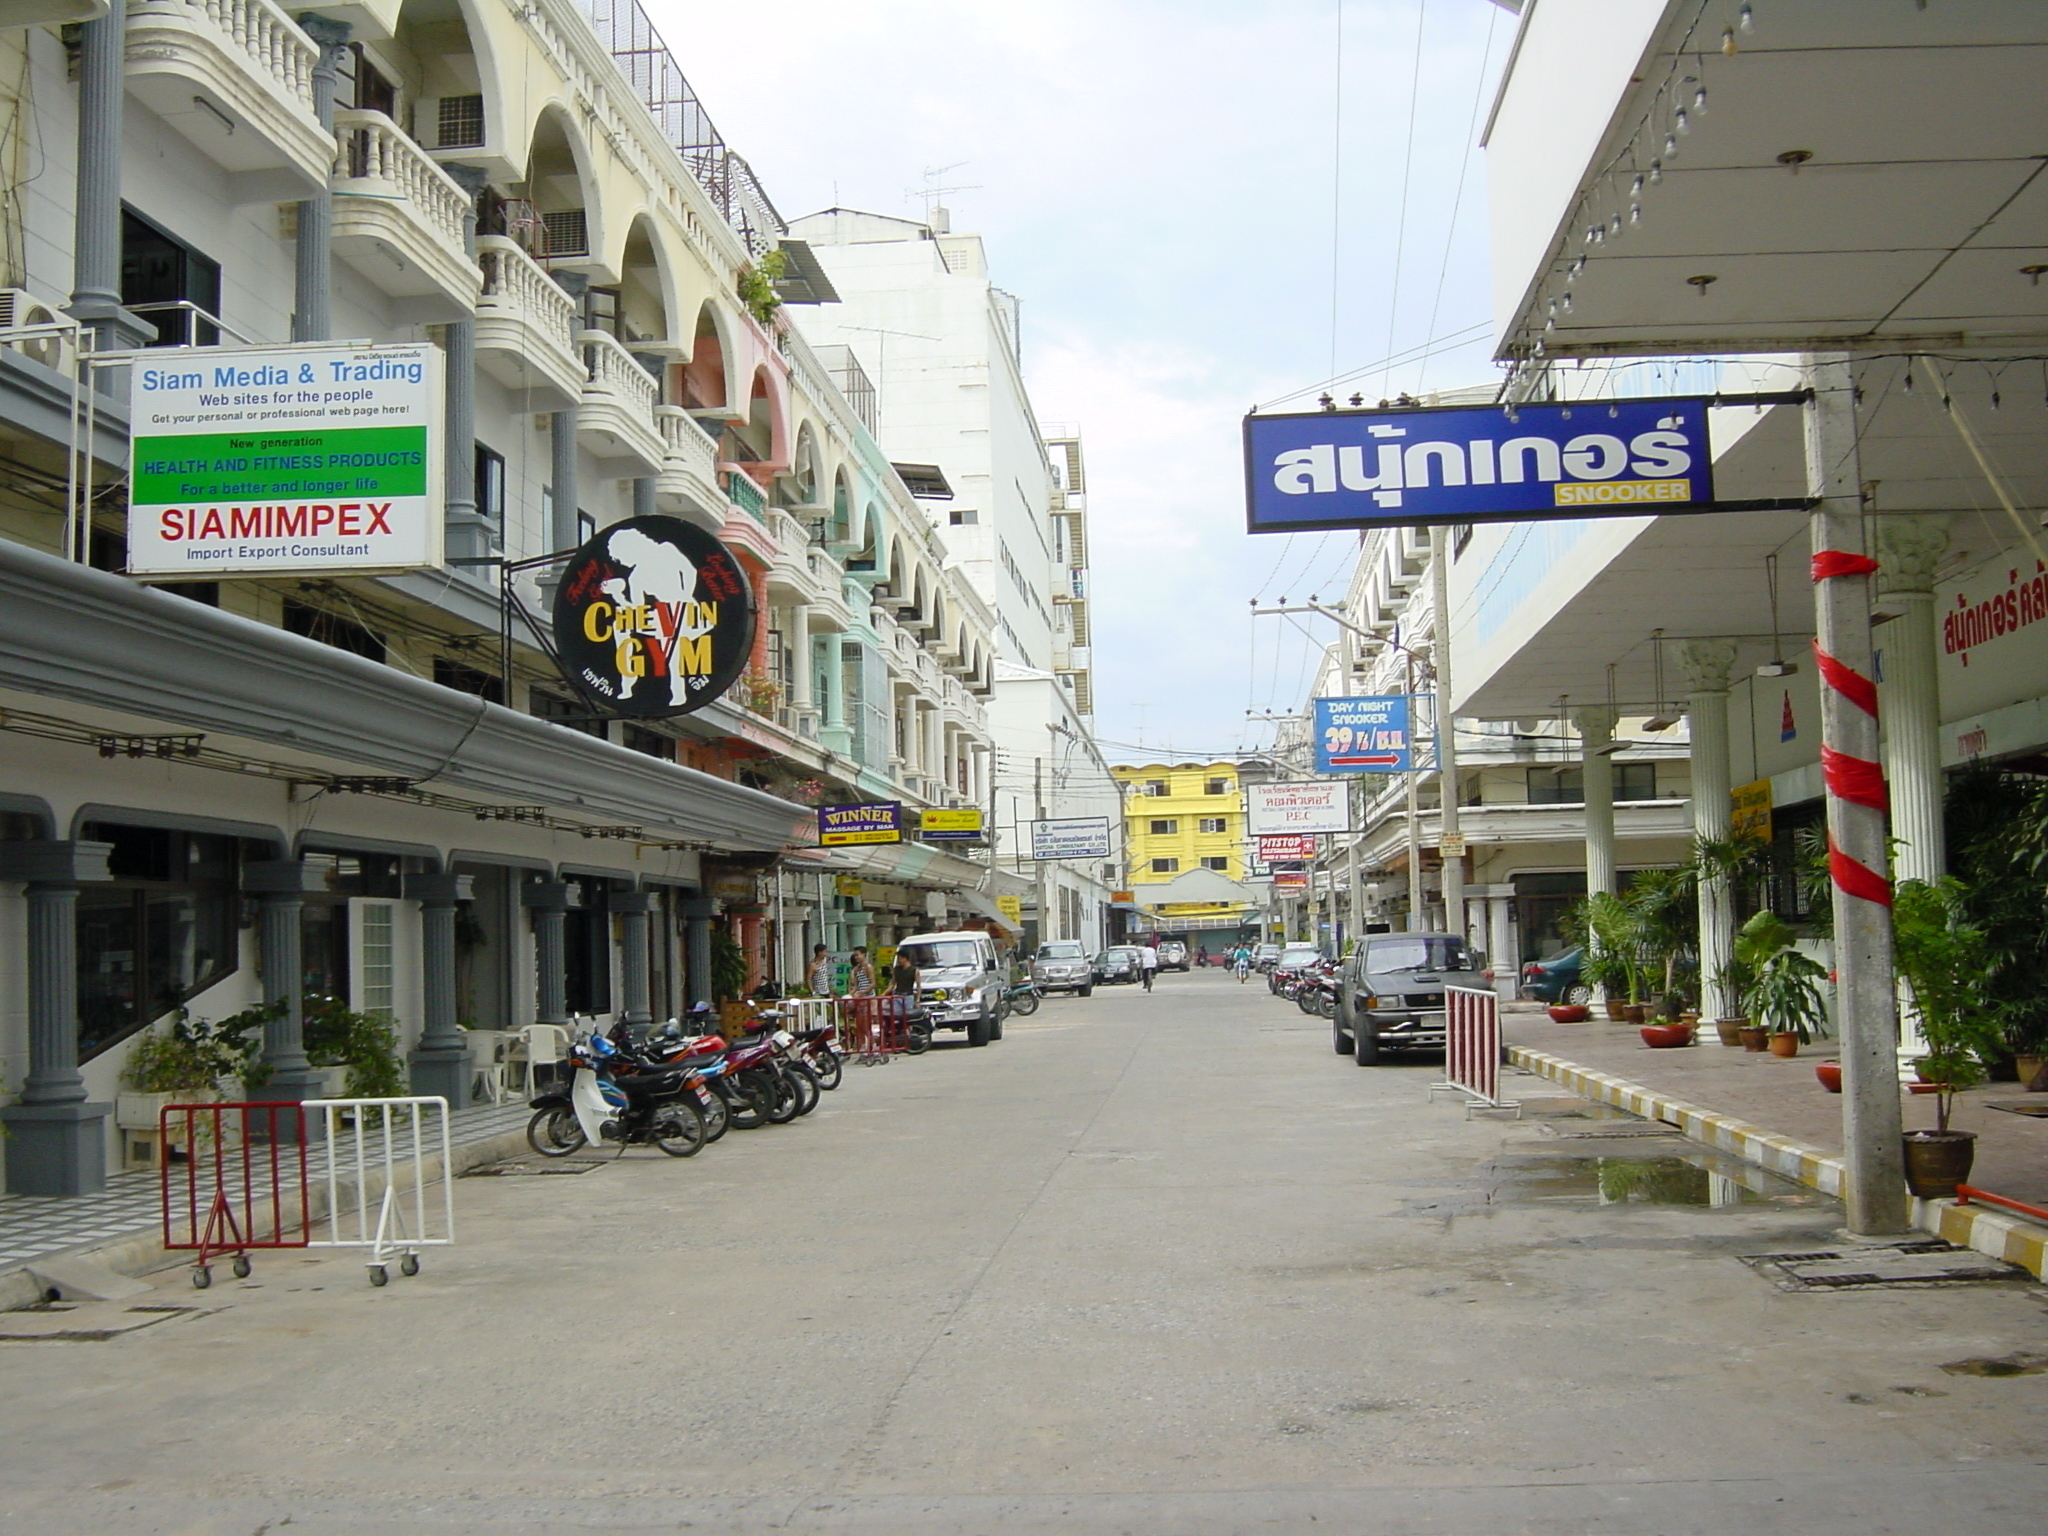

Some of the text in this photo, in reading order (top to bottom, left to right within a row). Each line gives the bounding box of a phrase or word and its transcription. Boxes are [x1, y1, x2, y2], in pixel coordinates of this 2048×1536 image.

[142, 359, 423, 391] Siam Media & Trading
[199, 388, 374, 406] Web sites for the people
[152, 405, 410, 425] Get your personal or professional web page here!
[230, 436, 323, 450] New generation
[144, 451, 422, 475] HEALTH AND FITNESS PRODUCTS
[181, 477, 379, 496] For a better and longer life
[1558, 483, 1688, 504] SNOOKER
[159, 502, 393, 541] SIAMIMPEX
[187, 543, 370, 560] Import Export Consultant
[583, 600, 718, 643] CHEVIN
[615, 635, 713, 677] GYM
[1328, 701, 1394, 713] DAY NIGHT
[1332, 713, 1389, 725] SNOOKER
[1325, 726, 1353, 753] 39
[826, 809, 893, 825] WINNER
[825, 825, 861, 833] MASSAGE
[877, 823, 894, 831] MAN
[1261, 837, 1301, 848] PITSTOP
